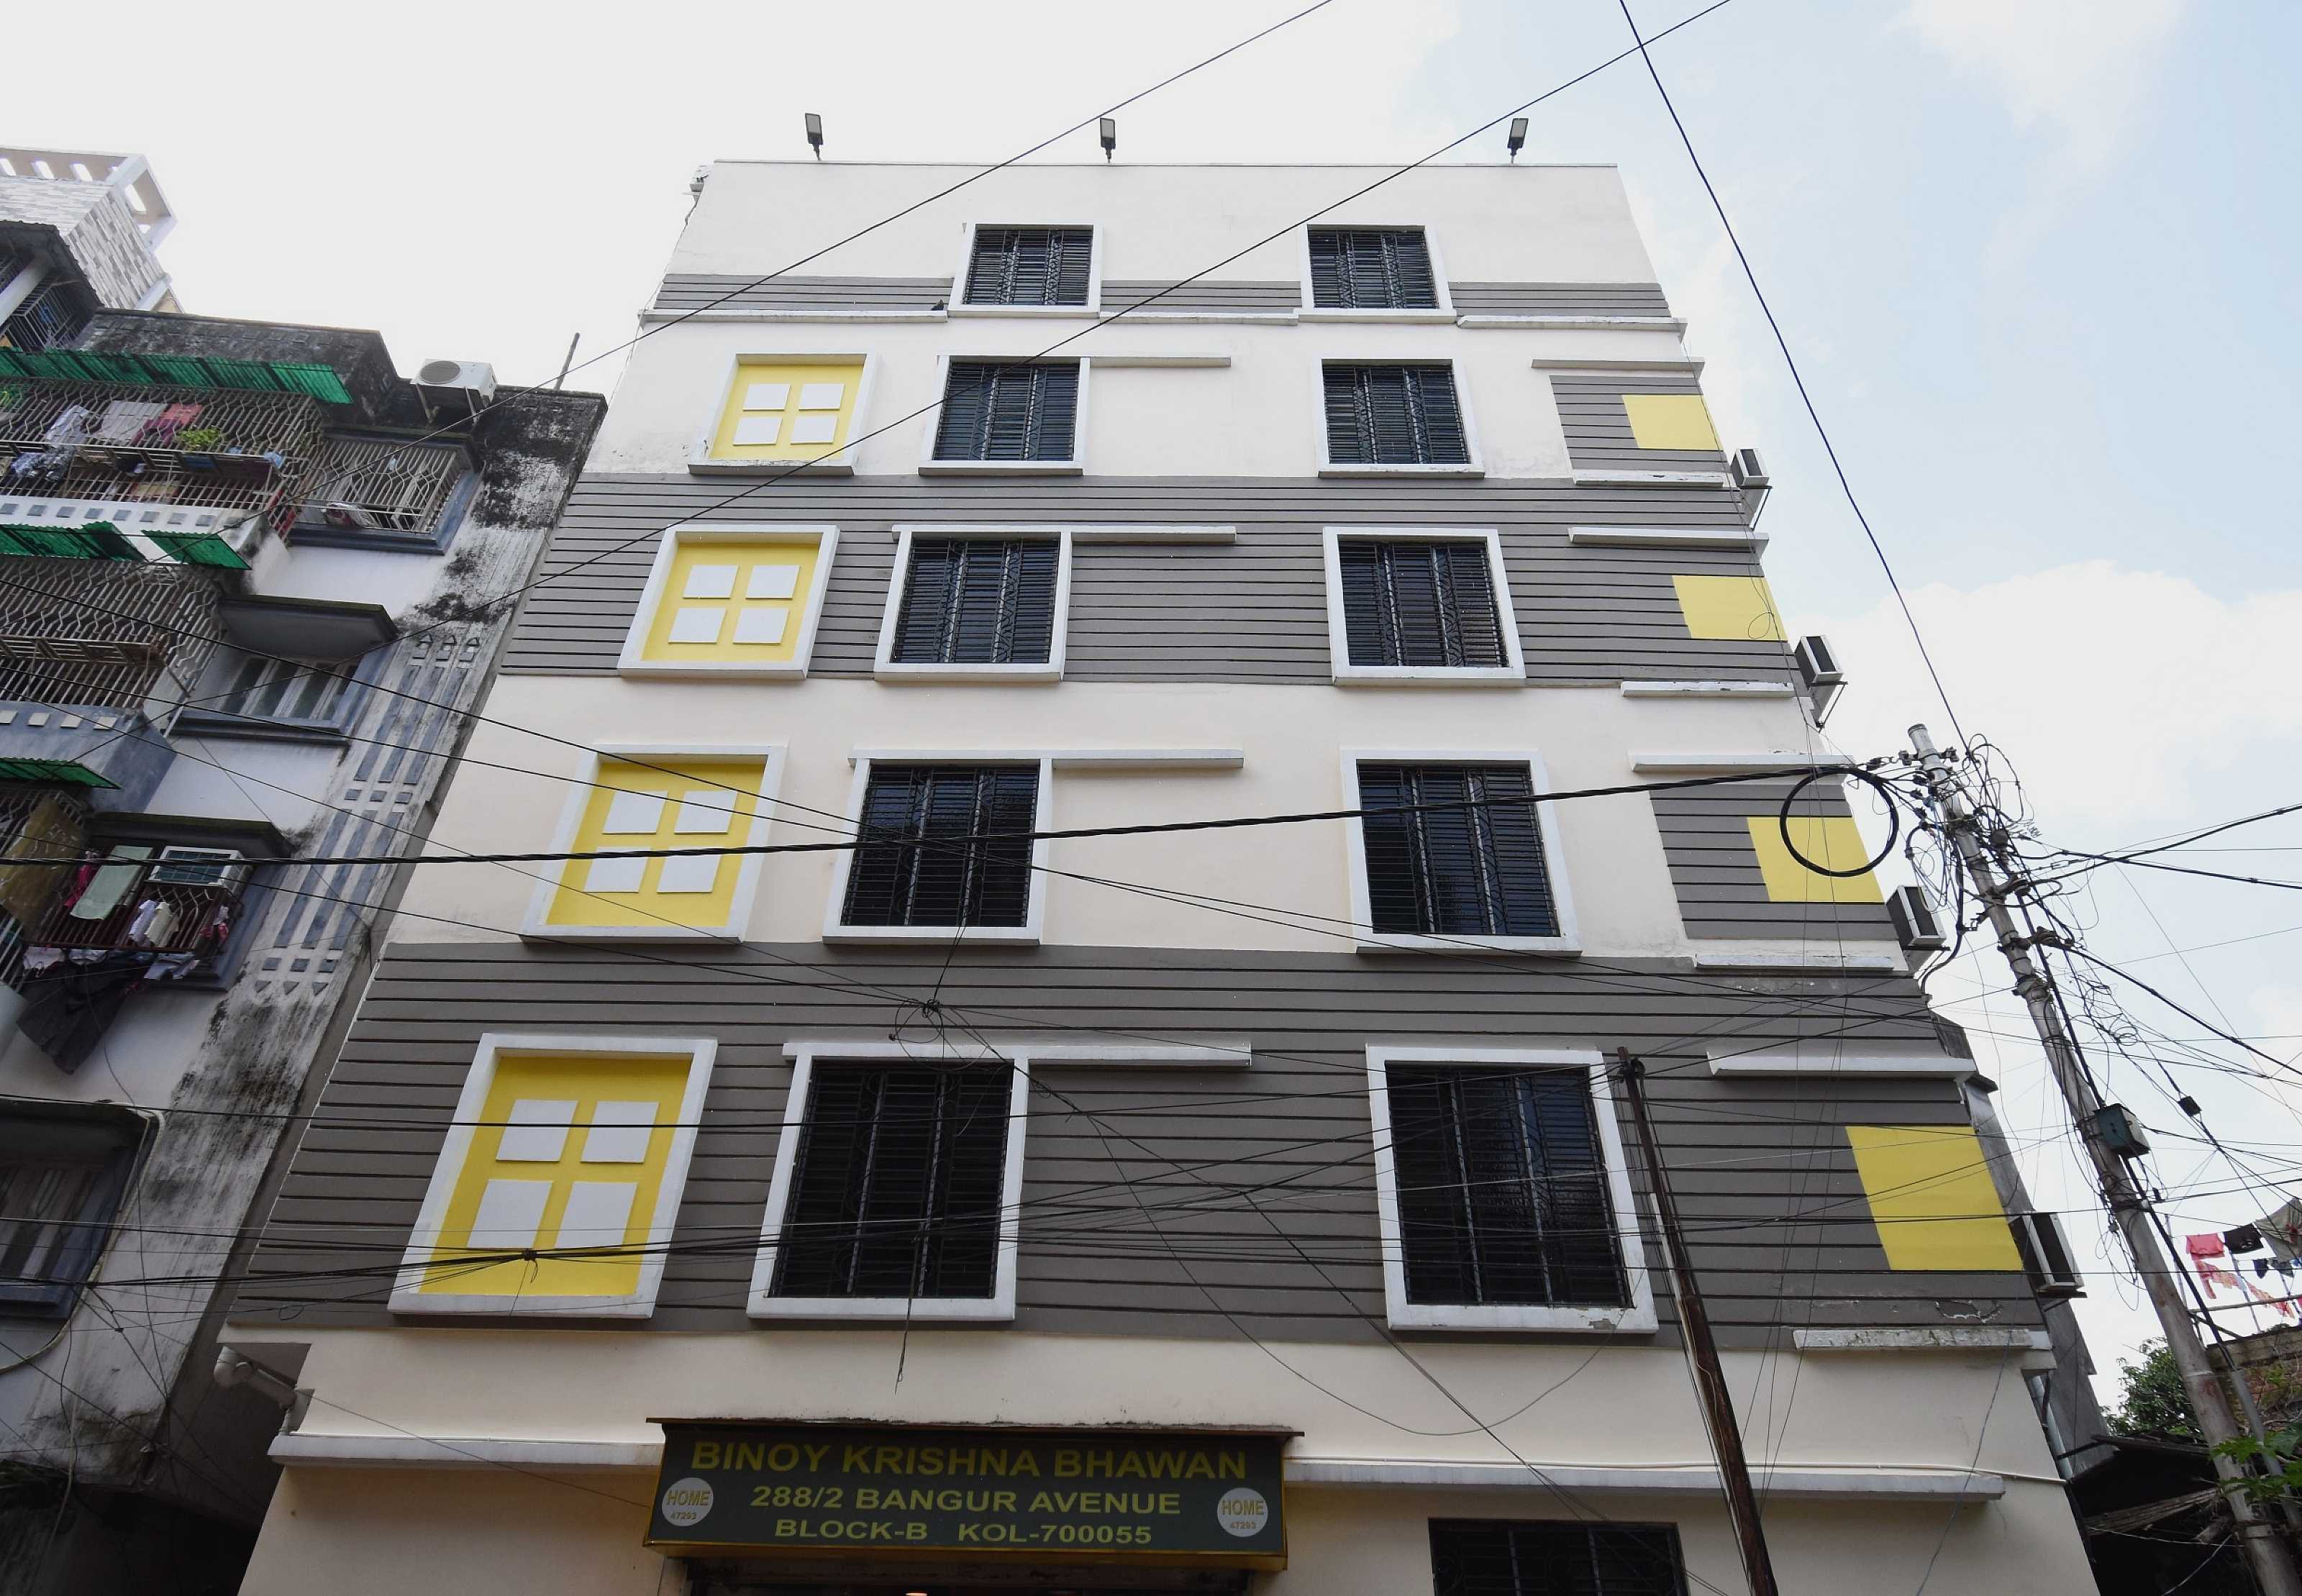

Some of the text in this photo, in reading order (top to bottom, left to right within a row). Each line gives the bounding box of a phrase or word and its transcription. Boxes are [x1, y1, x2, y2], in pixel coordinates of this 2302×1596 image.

[691, 1441, 1245, 1479] BINOY KRISHNA BHAWAN
[667, 1490, 711, 1506] HOME
[750, 1486, 1180, 1514] 288/2 BANGUR AVENUE
[1222, 1500, 1264, 1515] HOME
[775, 1519, 1151, 1544] BLOCK-B KOL-700055
